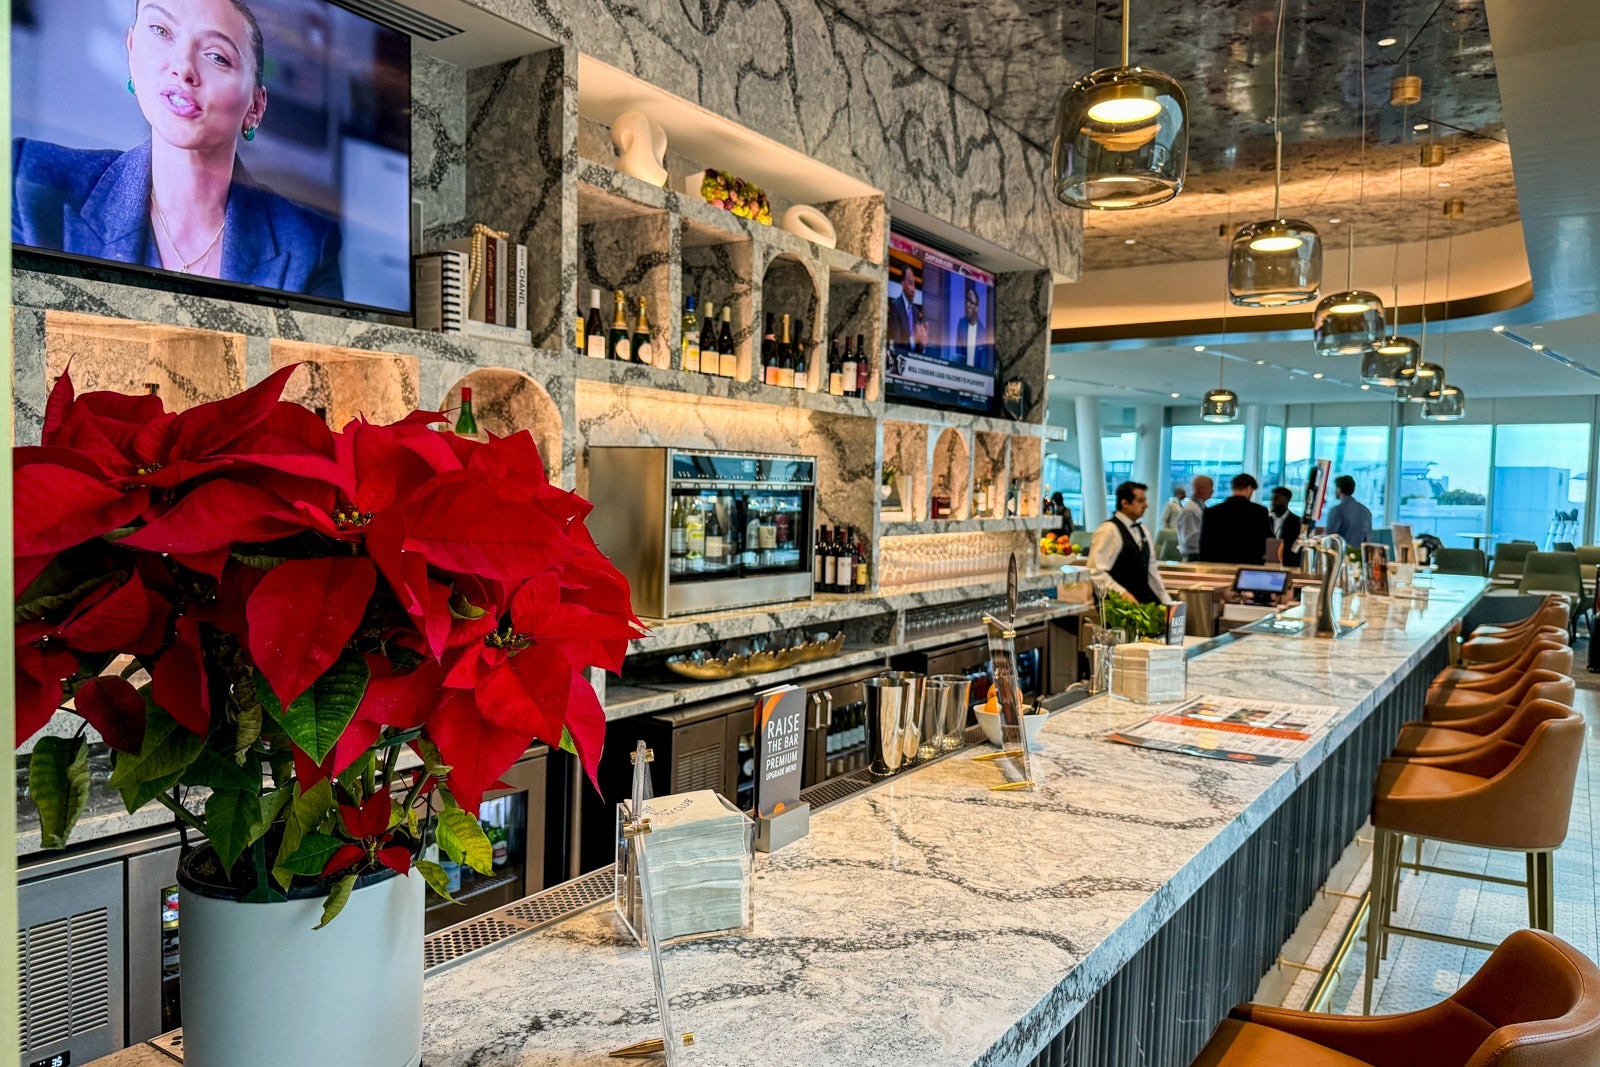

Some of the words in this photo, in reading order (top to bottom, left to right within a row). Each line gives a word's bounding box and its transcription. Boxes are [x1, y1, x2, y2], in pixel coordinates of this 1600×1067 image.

[490, 328, 511, 338] WHITE
[907, 365, 918, 374] WILL
[767, 713, 800, 739] RAISE
[767, 738, 782, 754] THE
[784, 733, 799, 749] BAR
[766, 750, 798, 771] PREMIUM
[765, 767, 785, 781] UPGRADE
[785, 763, 798, 774] MENU
